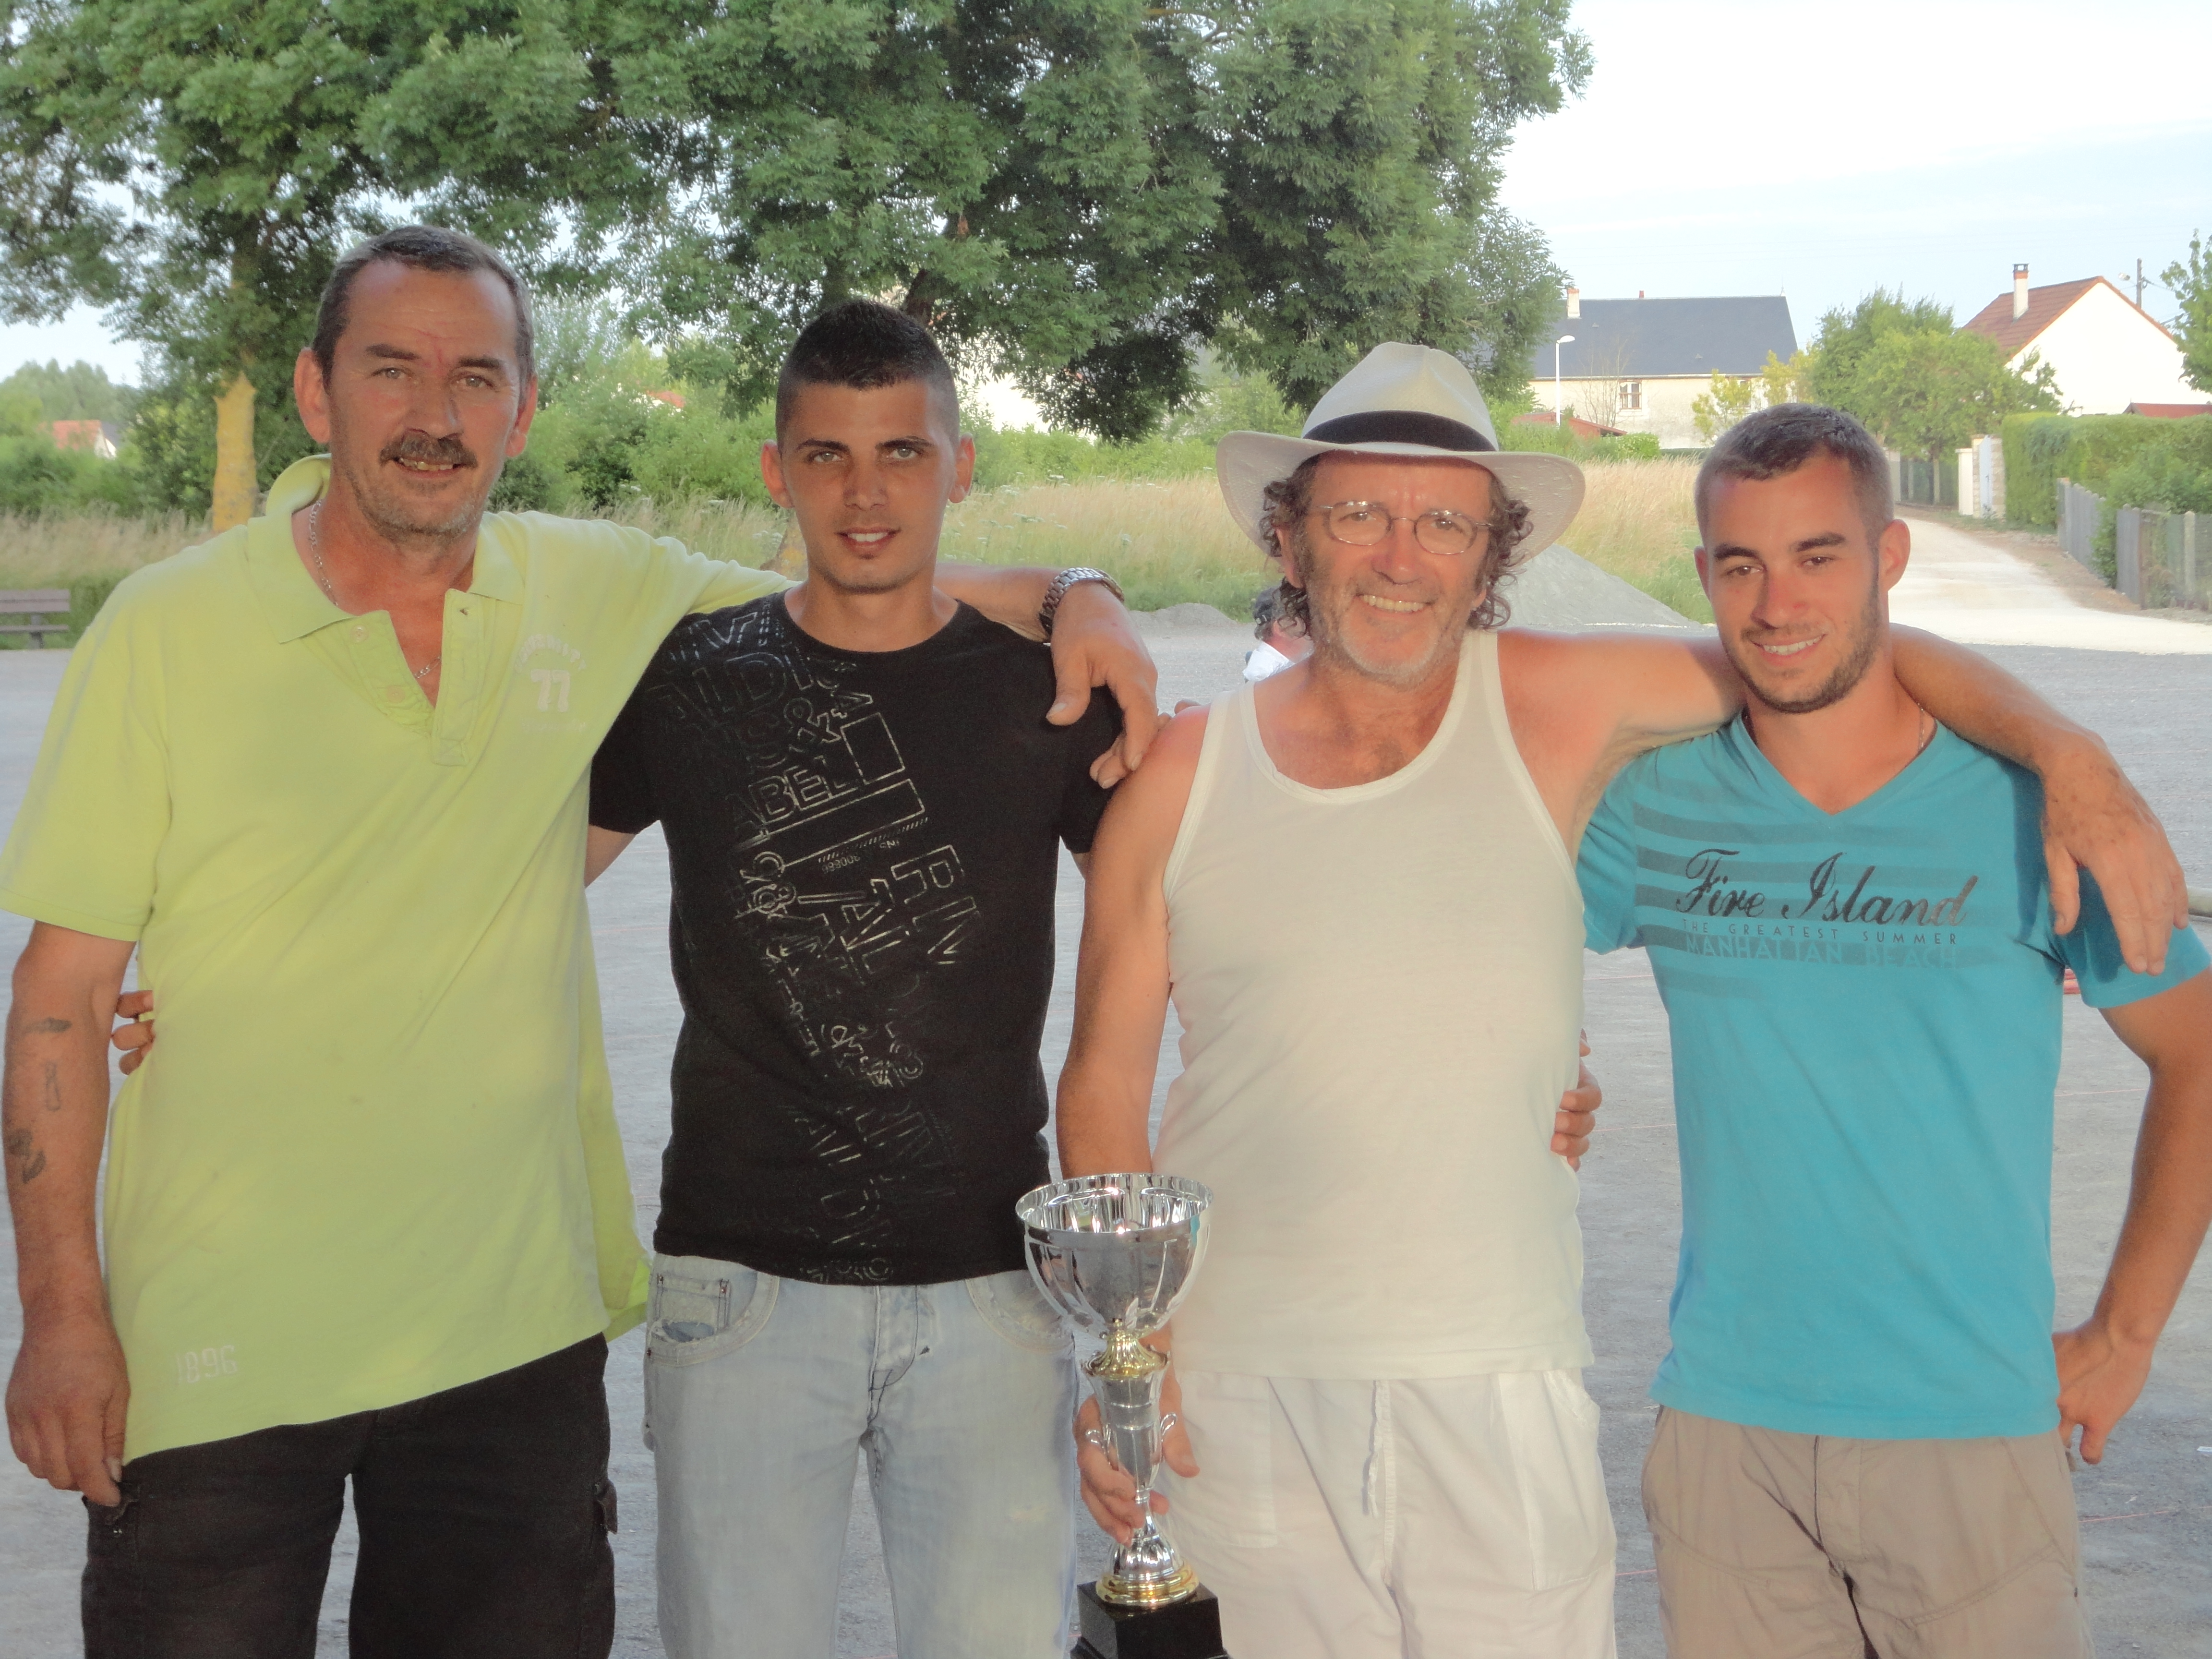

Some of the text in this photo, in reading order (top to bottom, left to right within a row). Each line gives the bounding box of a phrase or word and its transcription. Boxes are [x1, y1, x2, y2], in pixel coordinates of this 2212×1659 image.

[1676, 848, 1979, 927] Fire Island
[1682, 918, 1957, 945] THE GREATEST SUMMER
[1685, 933, 1957, 969] MANHATTAN BEACH
